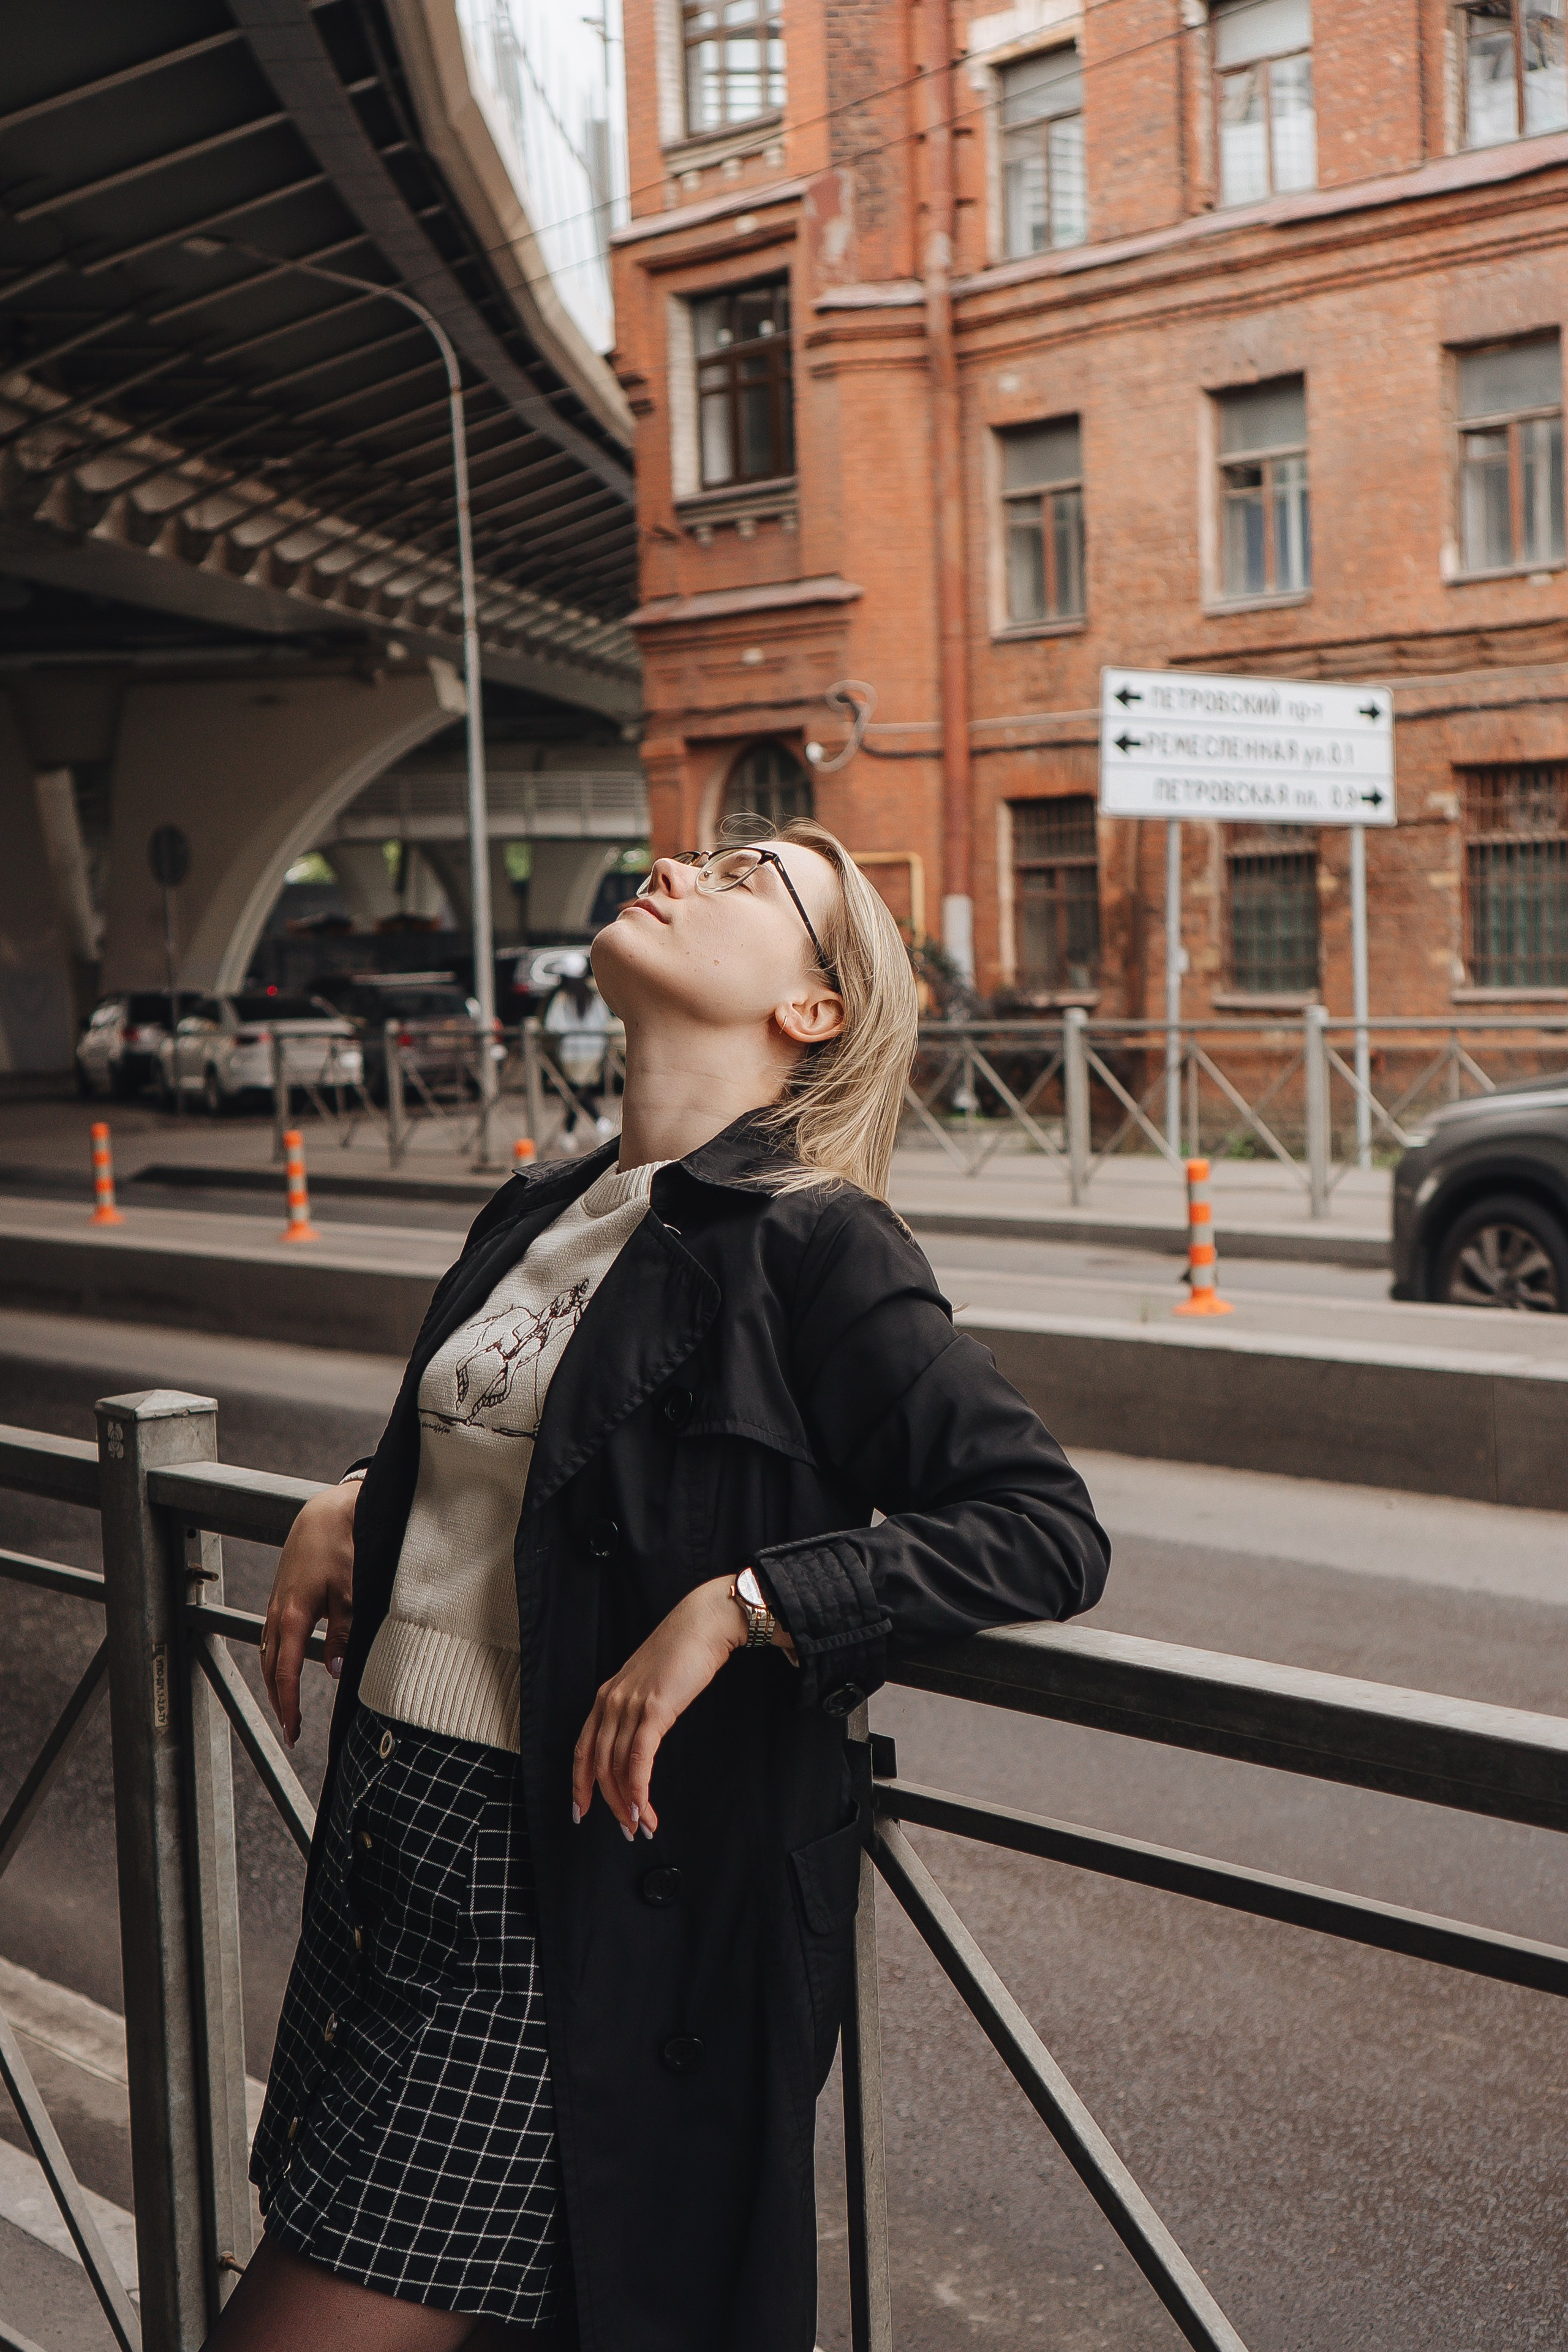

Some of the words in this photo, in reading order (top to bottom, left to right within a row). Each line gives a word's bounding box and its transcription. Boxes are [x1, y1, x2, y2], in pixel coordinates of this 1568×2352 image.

[1150, 685, 1281, 717] ПЕТРОВСКИЙ
[1147, 734, 1297, 763] РЕМЕСЛЕННАЯ
[1155, 778, 1289, 806] ПЕТРОВСКАЯ
